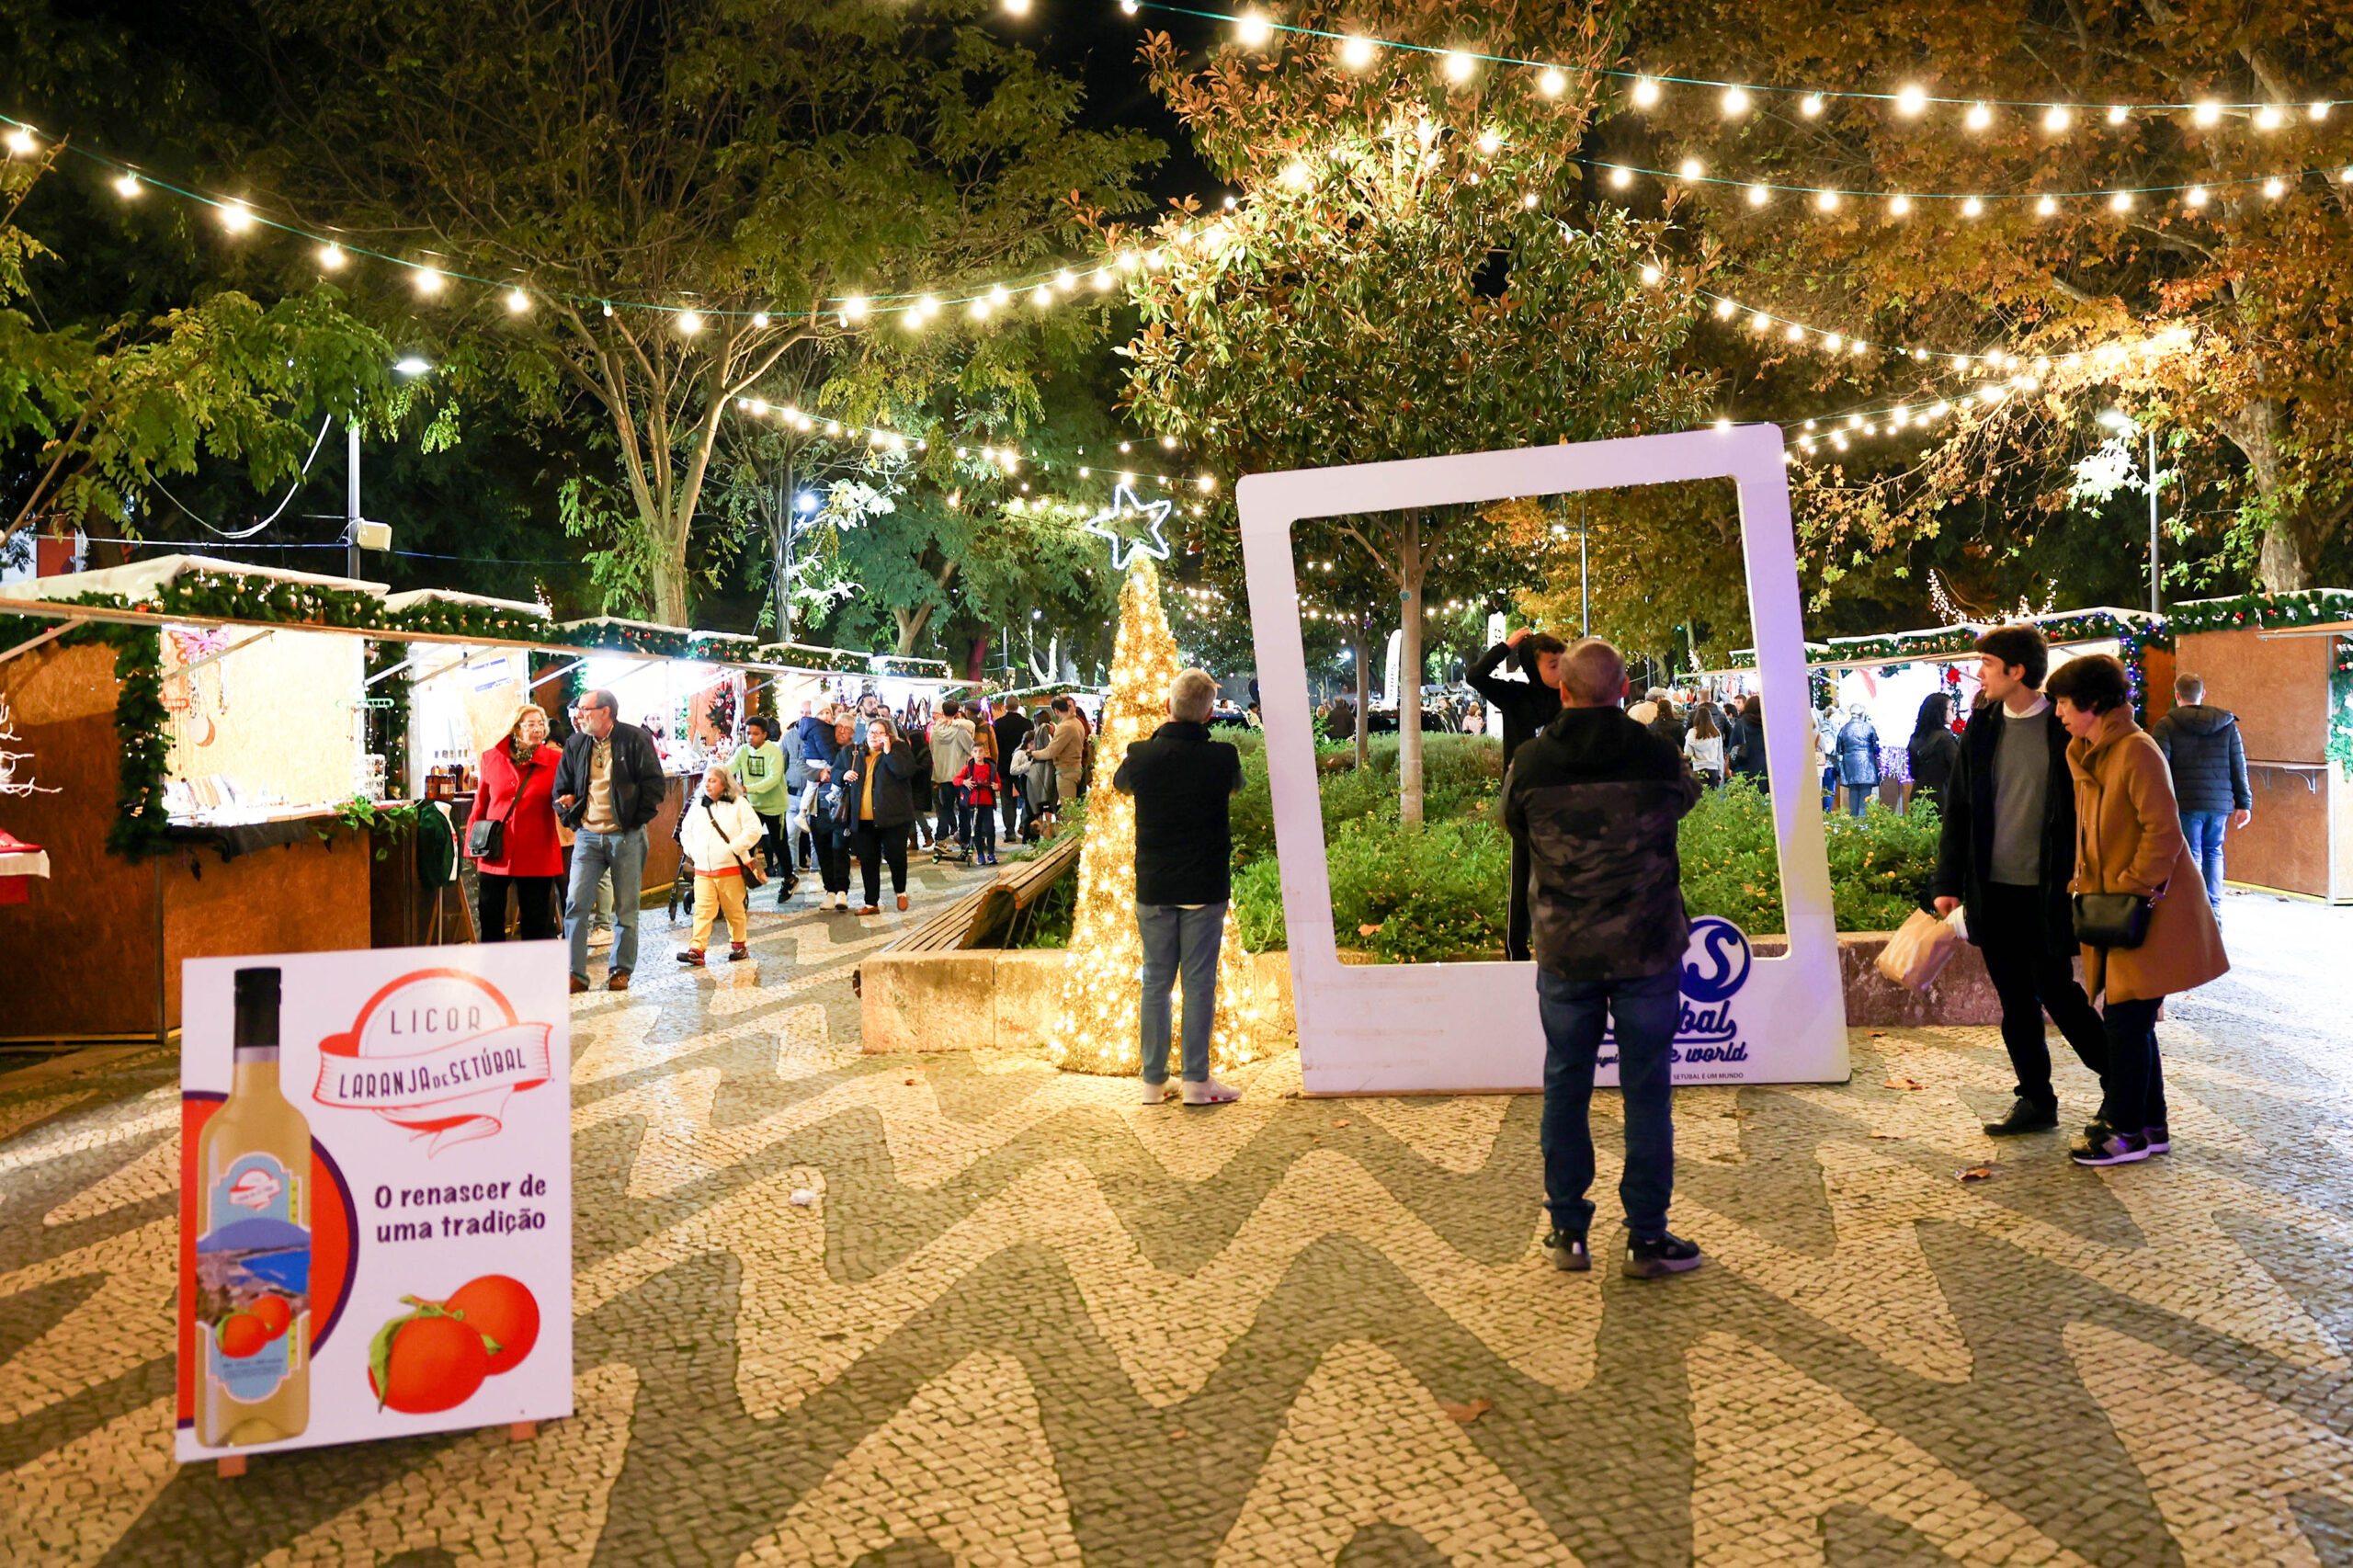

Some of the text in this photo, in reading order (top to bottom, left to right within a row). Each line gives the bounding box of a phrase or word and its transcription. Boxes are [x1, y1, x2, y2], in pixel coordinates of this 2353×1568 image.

[391, 1006, 481, 1035] LICOR
[1685, 1041, 1748, 1062] world
[338, 1066, 430, 1099] LARANJA
[449, 1047, 527, 1085] SETÚBAL
[375, 1173, 546, 1209] O renascer de
[377, 1208, 546, 1243] uma tradição
